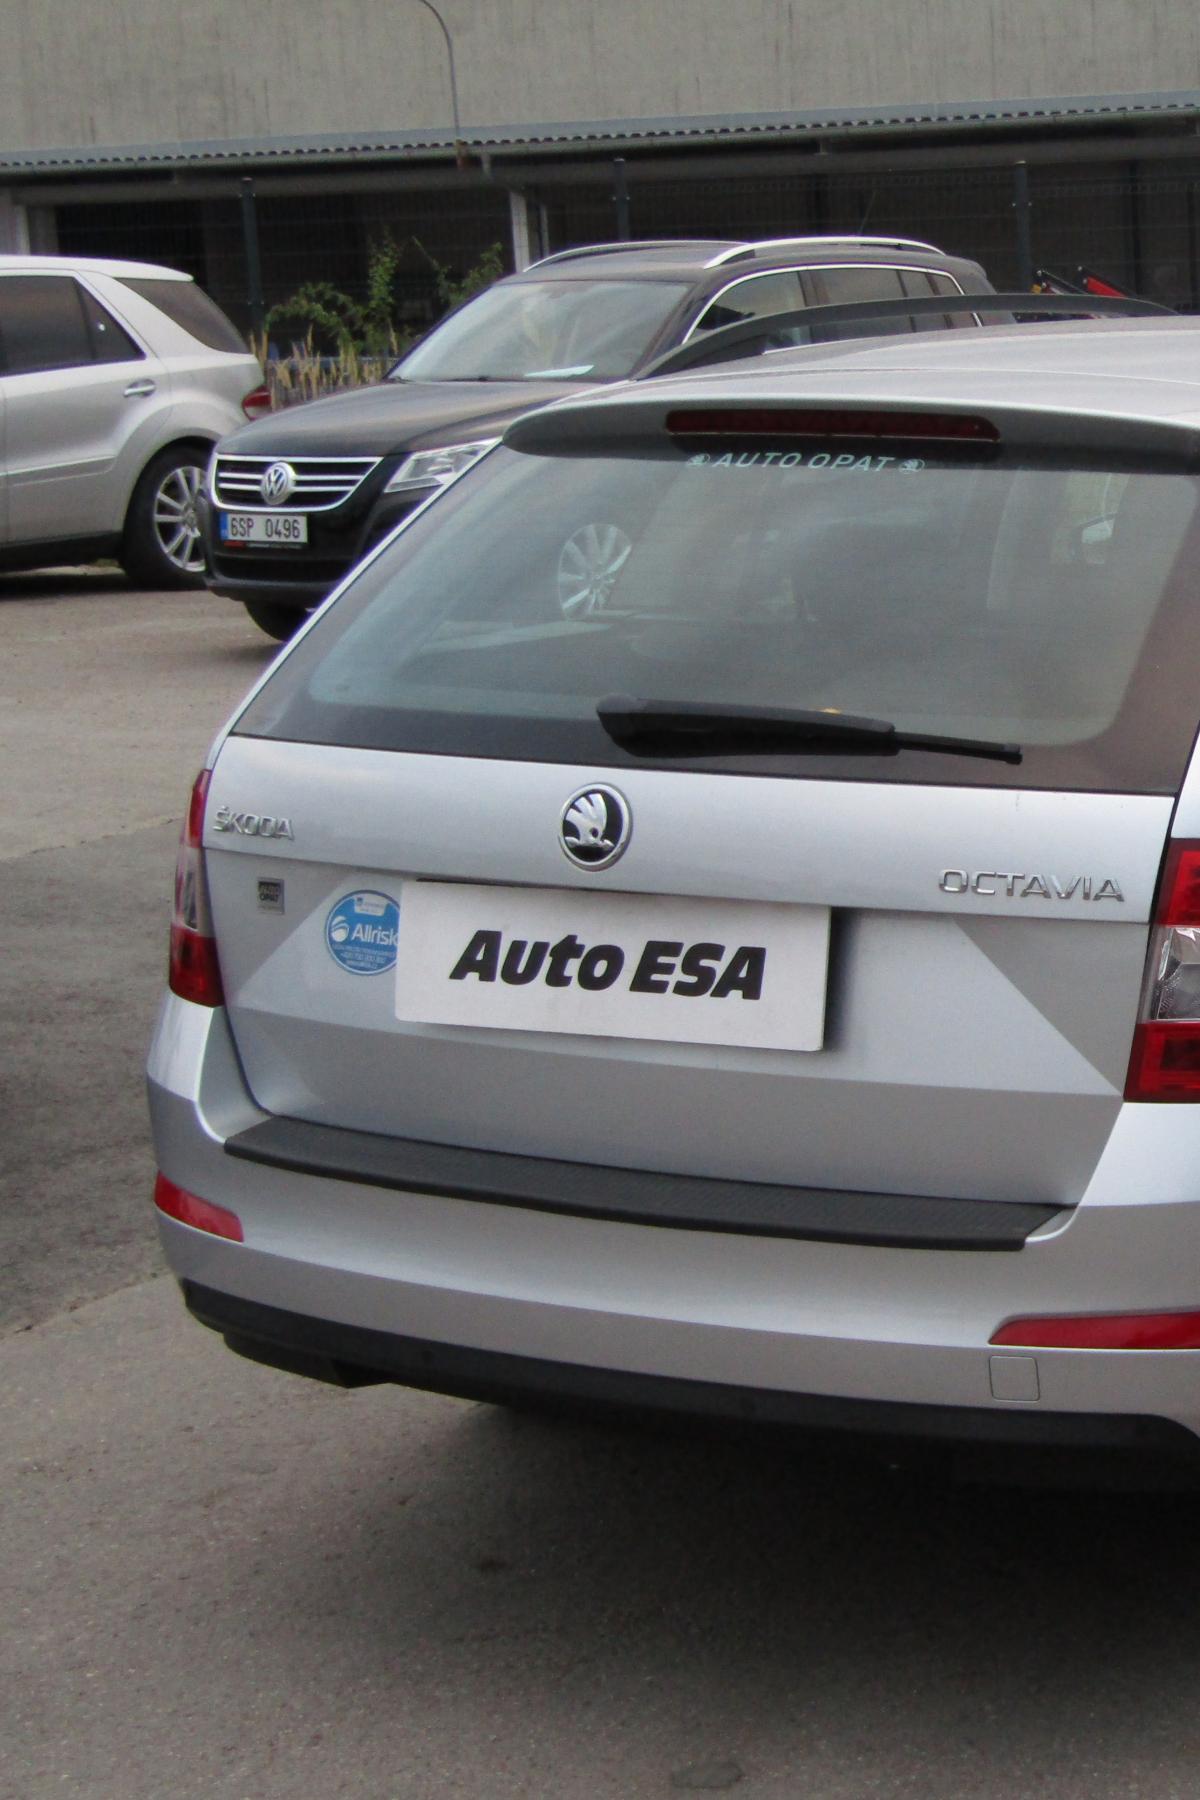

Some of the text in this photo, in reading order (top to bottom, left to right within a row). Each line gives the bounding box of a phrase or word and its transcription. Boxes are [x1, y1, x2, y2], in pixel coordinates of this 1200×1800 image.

[712, 452, 896, 472] AUTO OPAT
[231, 517, 300, 538] 6SP 0496
[212, 805, 295, 841] ŠKODA
[938, 868, 1125, 902] OCTAVIA
[448, 929, 767, 1000] Auto ESA
